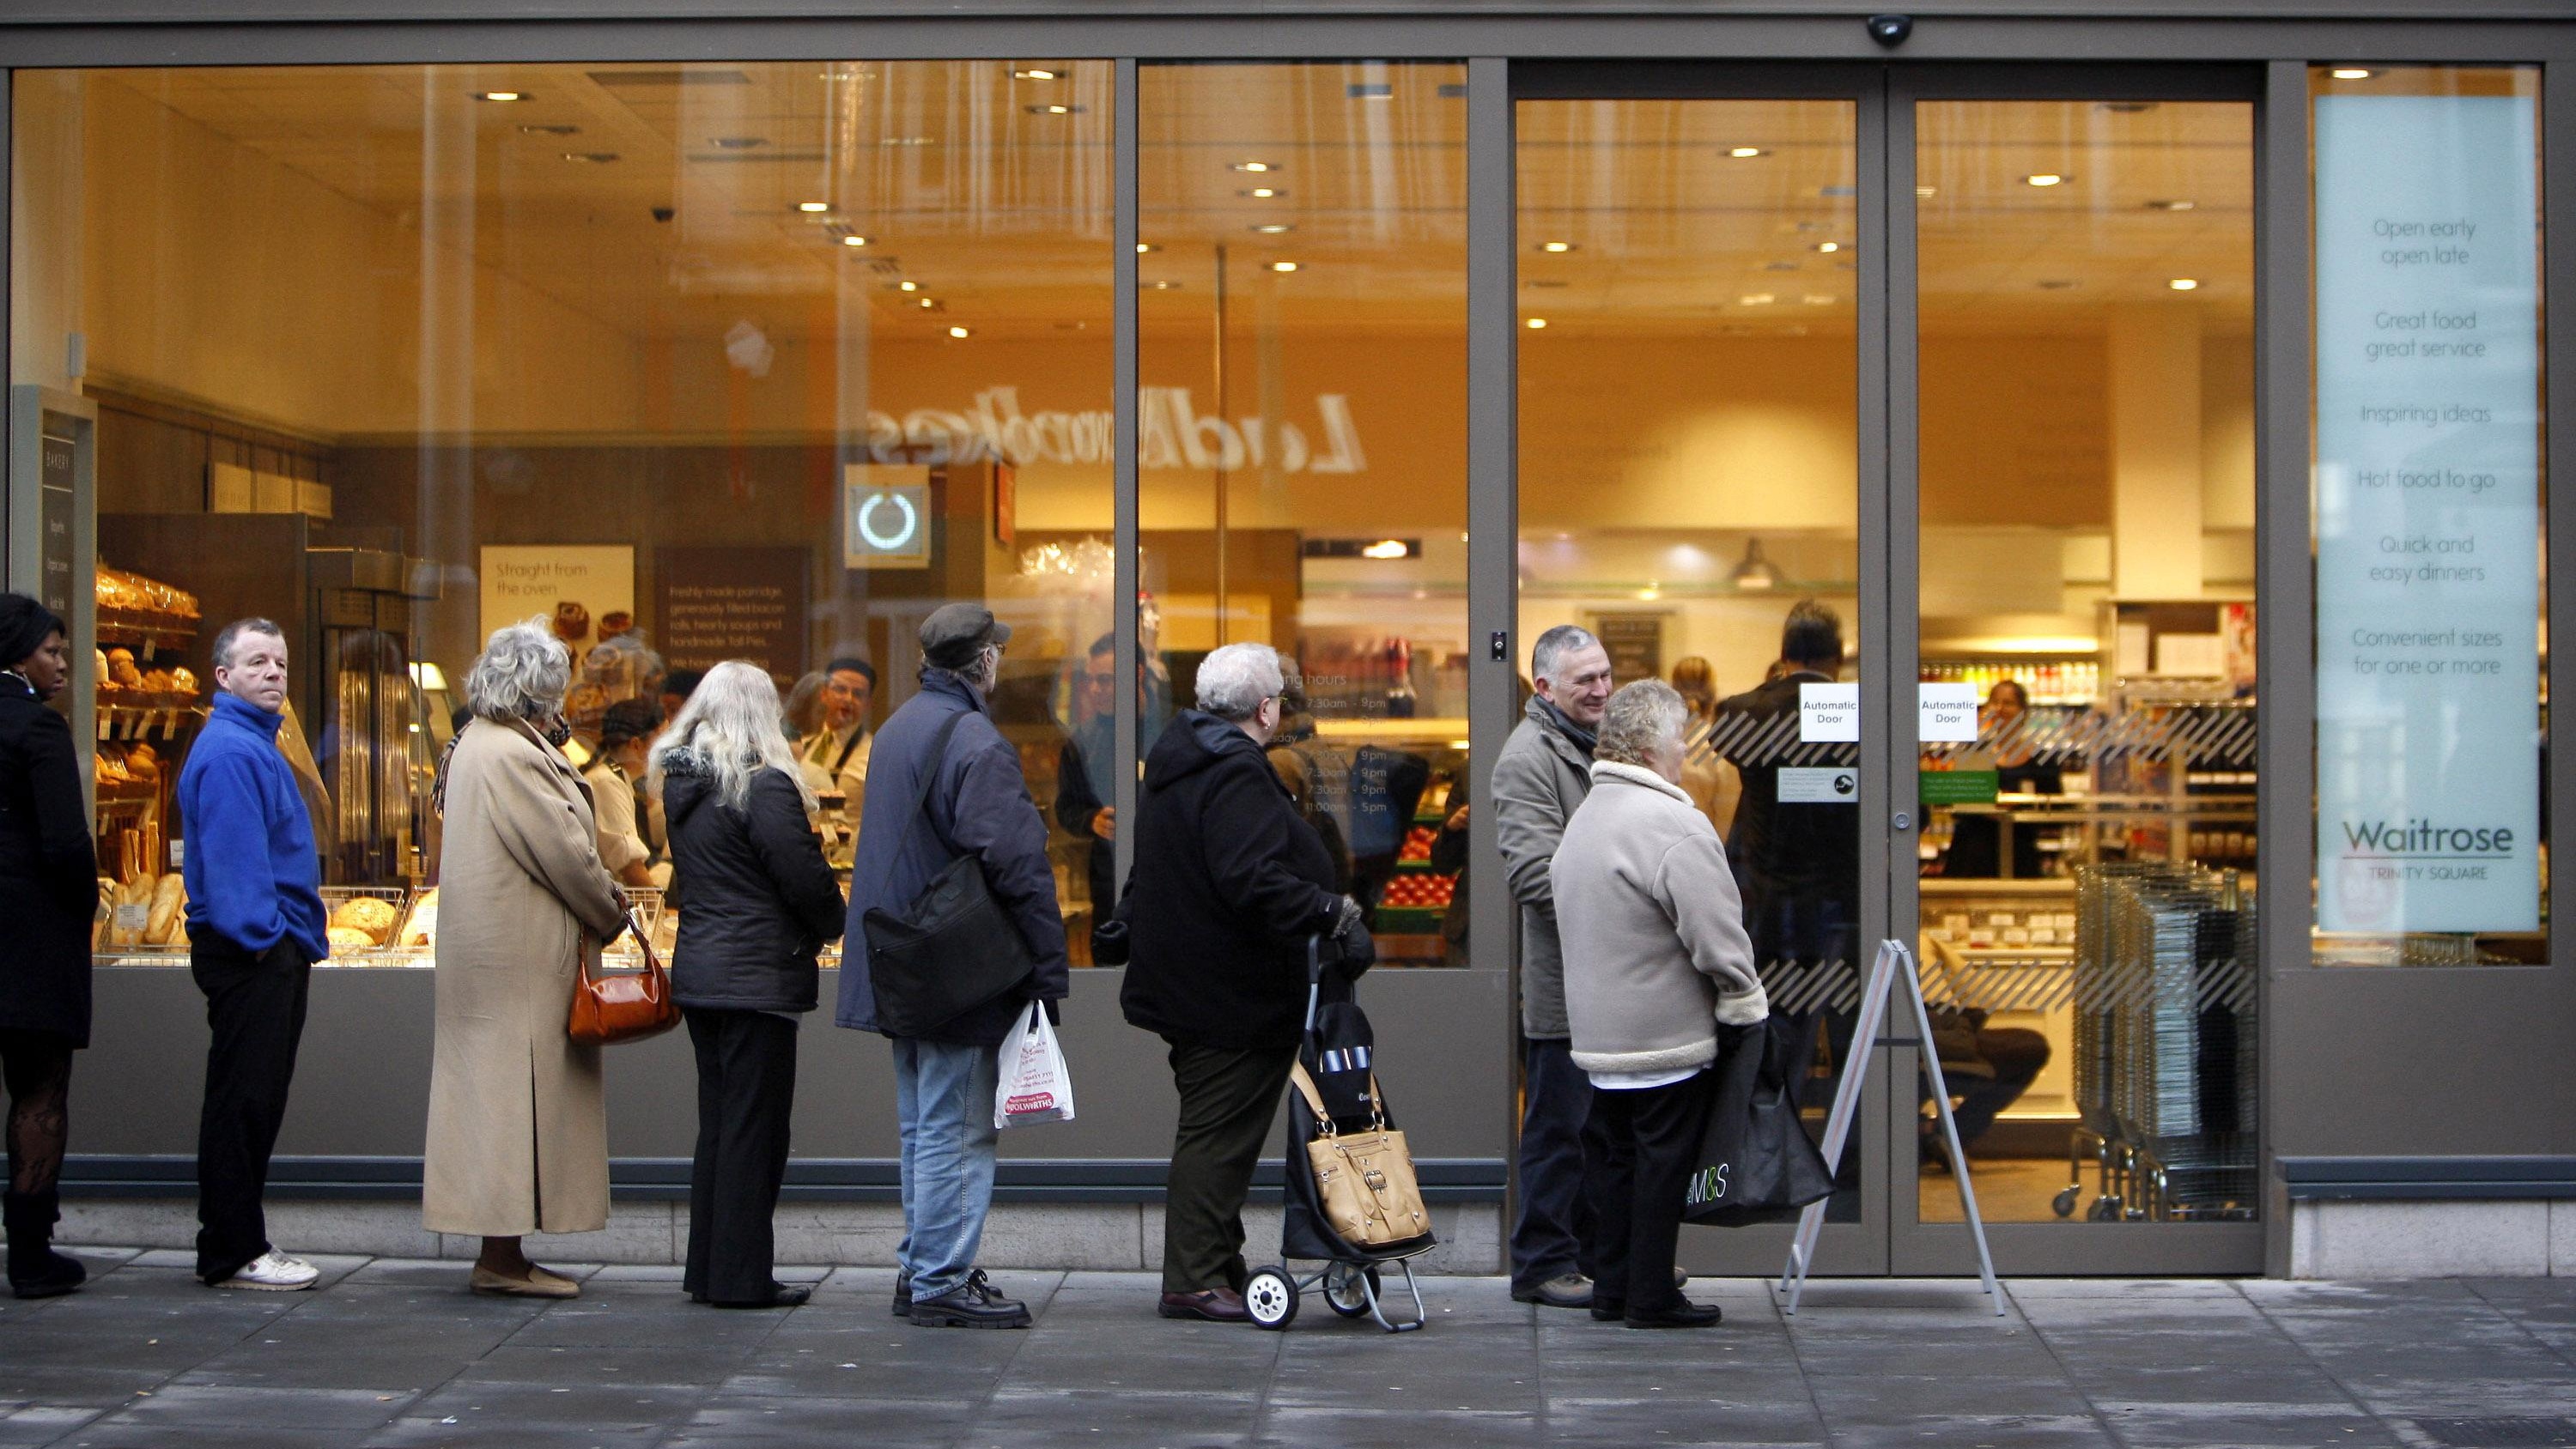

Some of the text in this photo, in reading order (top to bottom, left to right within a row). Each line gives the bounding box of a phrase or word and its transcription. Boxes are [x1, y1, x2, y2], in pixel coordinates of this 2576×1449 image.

[2373, 219, 2476, 241] Open early
[2381, 246, 2470, 268] open late
[2375, 311, 2476, 330] Great food
[2366, 338, 2486, 361] great service
[2360, 405, 2491, 427] Inspiring ideas
[2358, 470, 2495, 494] Hot food to go
[2380, 535, 2474, 554] Quick and
[495, 562, 587, 580] Straight from
[2370, 563, 2486, 585] easy dinners
[497, 580, 557, 596] the oven
[2351, 628, 2502, 647] Convenient sizes
[2354, 657, 2501, 675] for one or more
[1306, 671, 1347, 686] hours
[1361, 697, 1386, 710] 9pm
[1803, 700, 1856, 711] Automatic
[1922, 700, 1975, 711] Automatic
[1817, 714, 1843, 724] Door
[1935, 713, 1961, 724] Door
[1361, 750, 1387, 762] 9pm
[1361, 767, 1387, 779] 9pm
[1361, 784, 1386, 797] 9pm
[1361, 802, 1387, 815] 5pm
[2342, 818, 2513, 852] Waitrose
[2429, 866, 2488, 880] SQUARE
[1691, 1162, 1729, 1204] M&S
